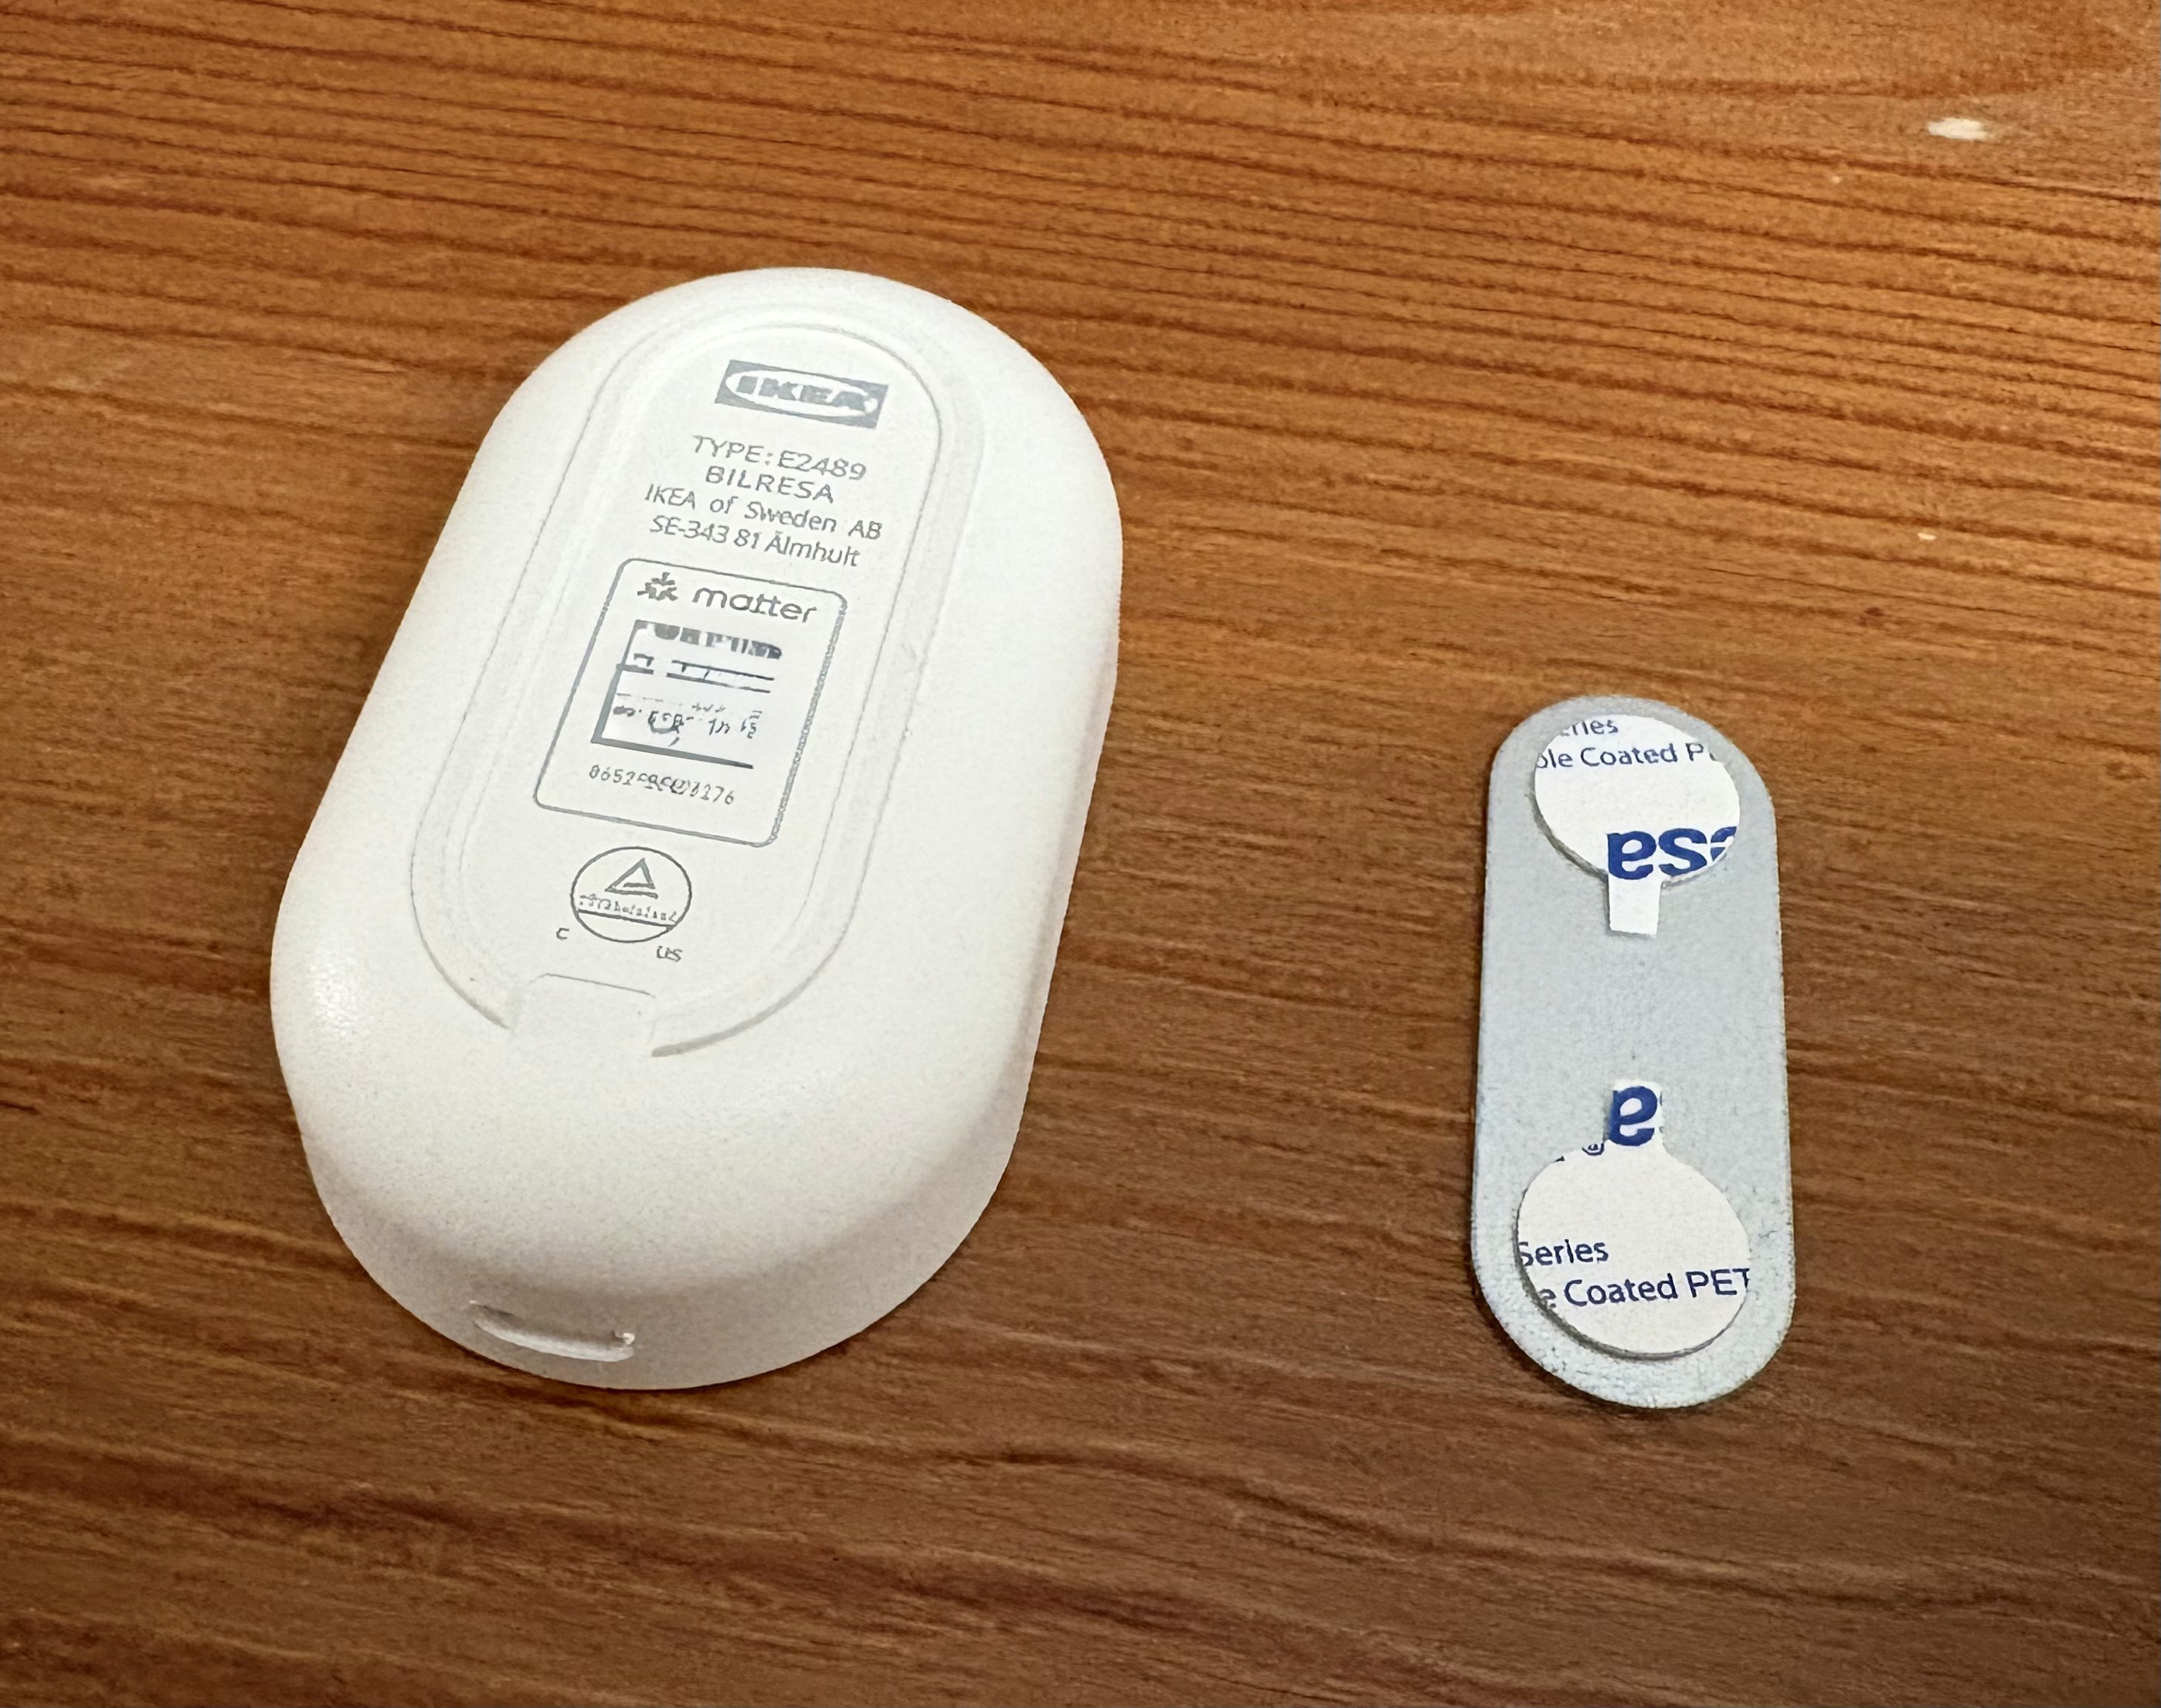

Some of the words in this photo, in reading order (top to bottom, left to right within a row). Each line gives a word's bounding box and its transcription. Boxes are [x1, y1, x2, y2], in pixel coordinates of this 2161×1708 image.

[693, 435, 773, 465] TYPE:
[777, 450, 867, 480] E2489
[705, 465, 834, 504] BILRESA
[644, 483, 695, 510] IKEA
[709, 495, 739, 514] of
[744, 501, 837, 533] Sweden
[848, 519, 882, 539] AB
[650, 514, 730, 544] SE-343
[733, 528, 762, 549] 81
[691, 587, 817, 623] matter
[1580, 742, 1678, 767] Coated
[1685, 742, 1717, 762] P
[1517, 1238, 1609, 1267] Series
[1564, 1272, 1678, 1307] Coated
